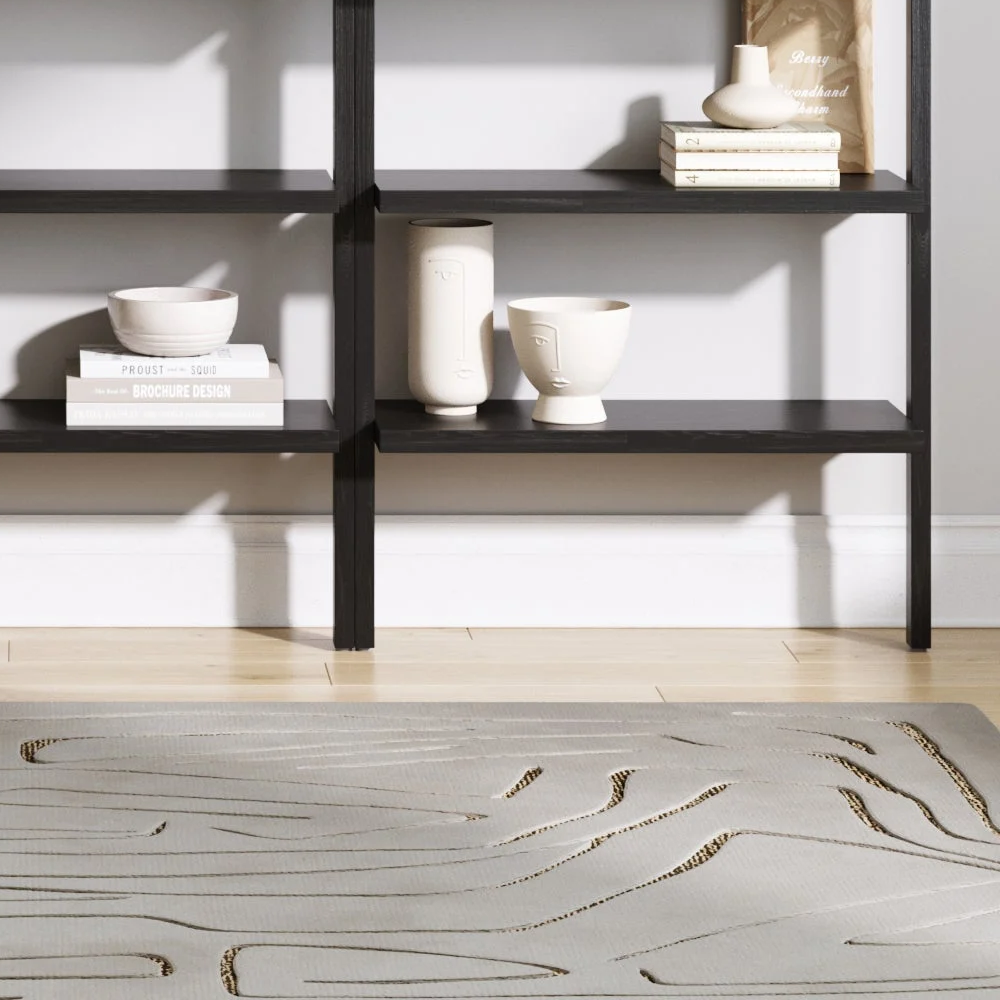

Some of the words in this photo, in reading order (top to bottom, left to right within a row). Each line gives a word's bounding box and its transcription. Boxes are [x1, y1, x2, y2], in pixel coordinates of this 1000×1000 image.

[796, 101, 830, 115] harm
[685, 138, 699, 146] 2
[685, 174, 699, 184] 4
[121, 365, 164, 375] PROUST
[191, 365, 217, 375] SQUID
[132, 384, 191, 398] BROCHURE
[193, 384, 231, 398] DESIGN
